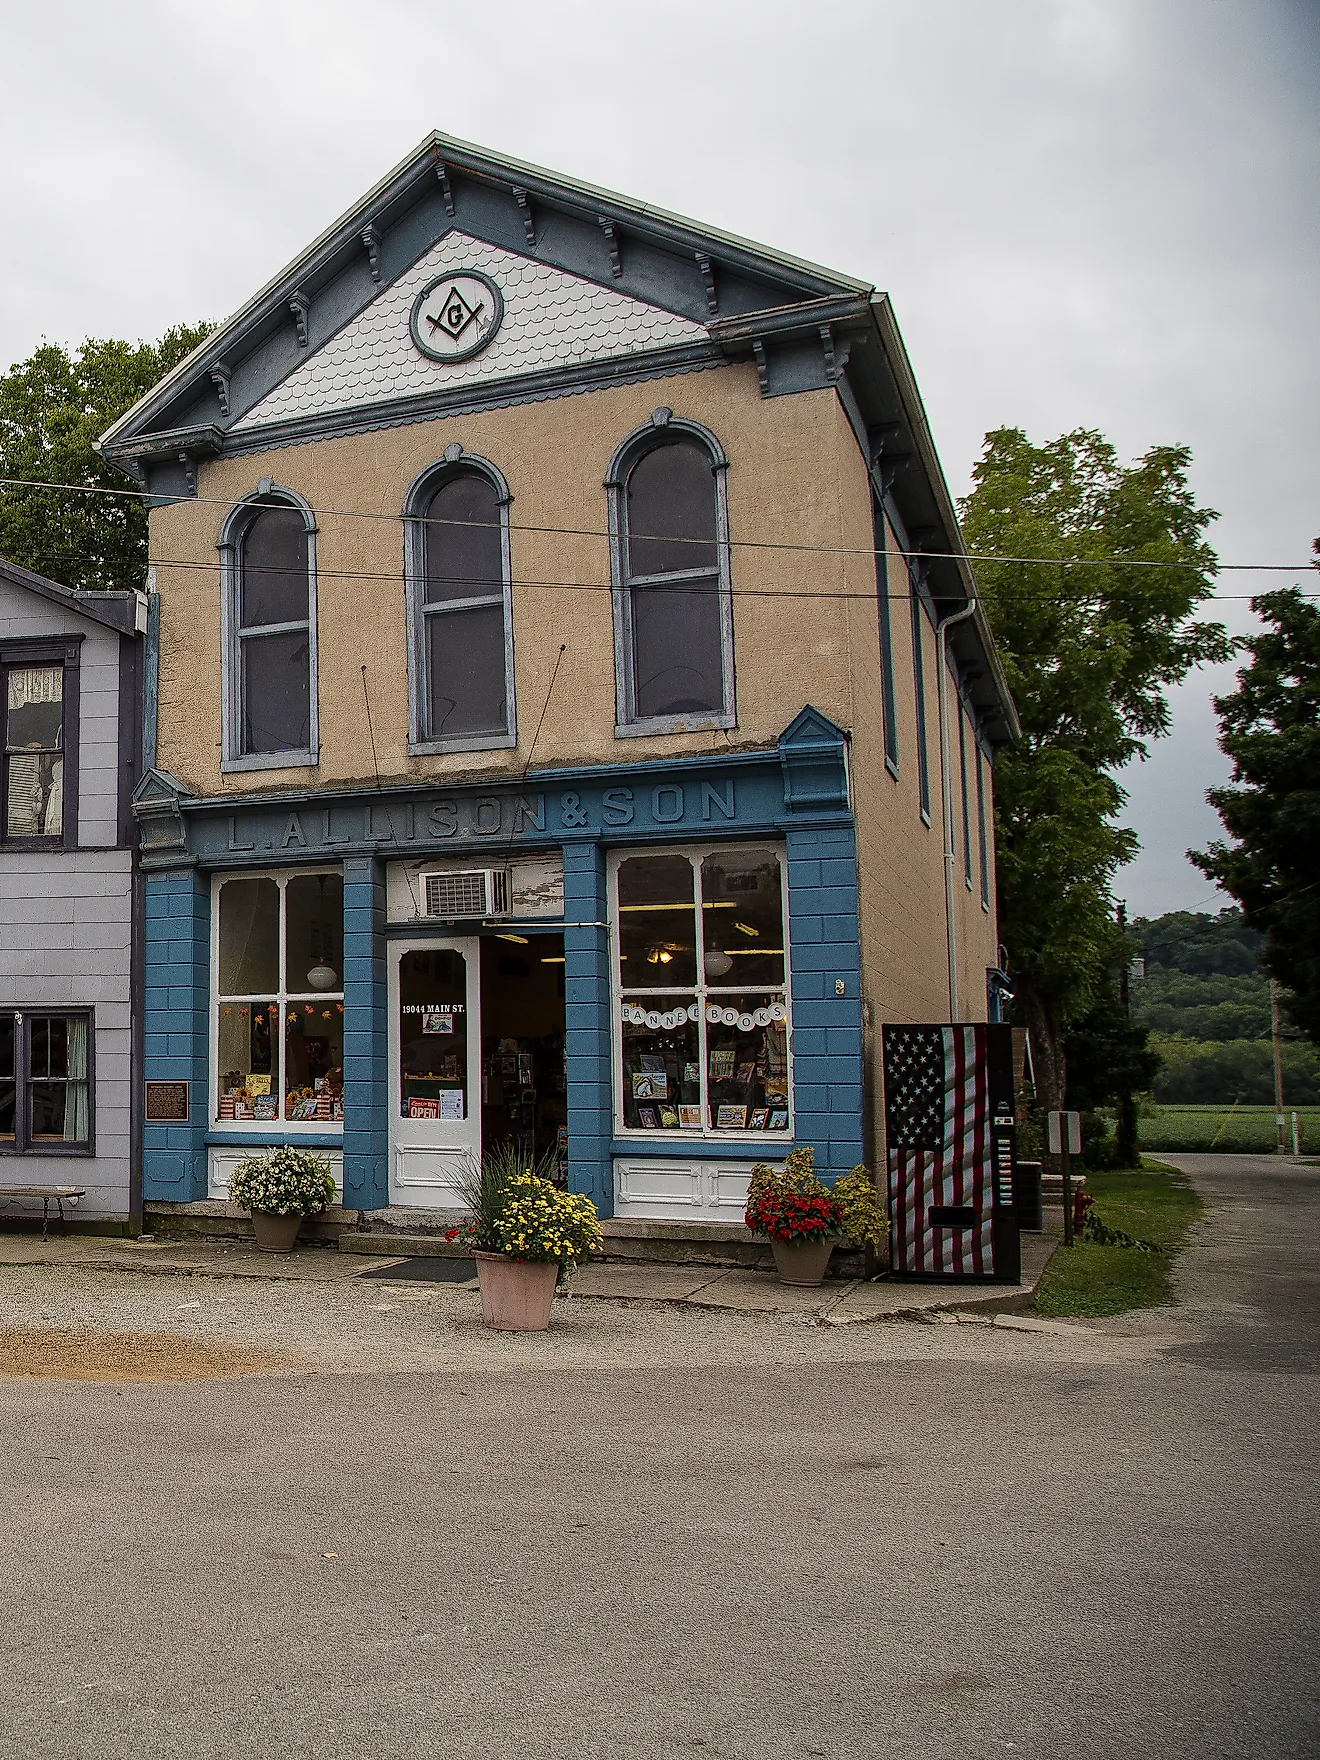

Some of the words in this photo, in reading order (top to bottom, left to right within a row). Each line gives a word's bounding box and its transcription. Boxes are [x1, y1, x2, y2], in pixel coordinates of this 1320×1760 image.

[448, 303, 464, 327] G
[281, 794, 547, 848] ALLISON
[560, 790, 589, 828] &
[602, 780, 736, 826] SON
[402, 1005, 426, 1013] 19044
[427, 1004, 450, 1013] MAIN
[452, 1004, 465, 1013] ST.
[711, 1006, 781, 1027] BOOKS
[411, 1107, 437, 1119] OPEN
